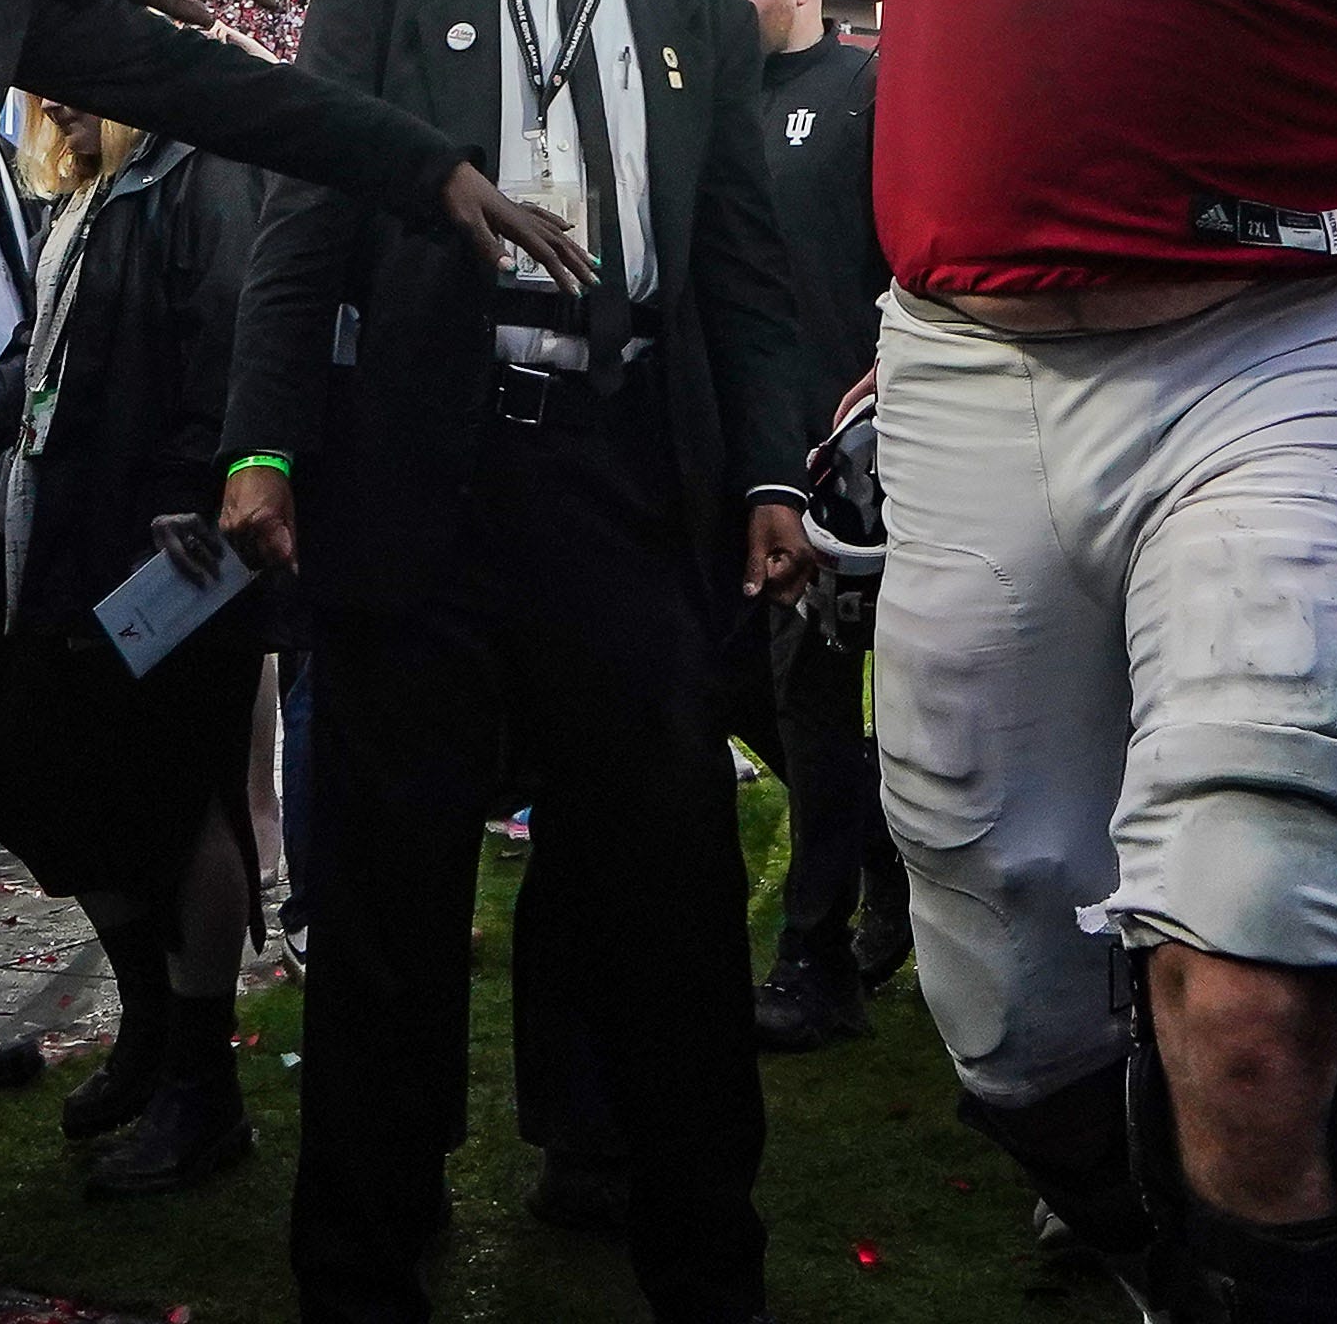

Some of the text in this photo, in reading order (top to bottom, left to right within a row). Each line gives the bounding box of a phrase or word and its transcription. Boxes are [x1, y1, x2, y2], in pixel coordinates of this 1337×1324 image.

[515, 0, 528, 21] ROSE
[520, 21, 533, 43] BOWL
[1247, 220, 1271, 239] 2XL
